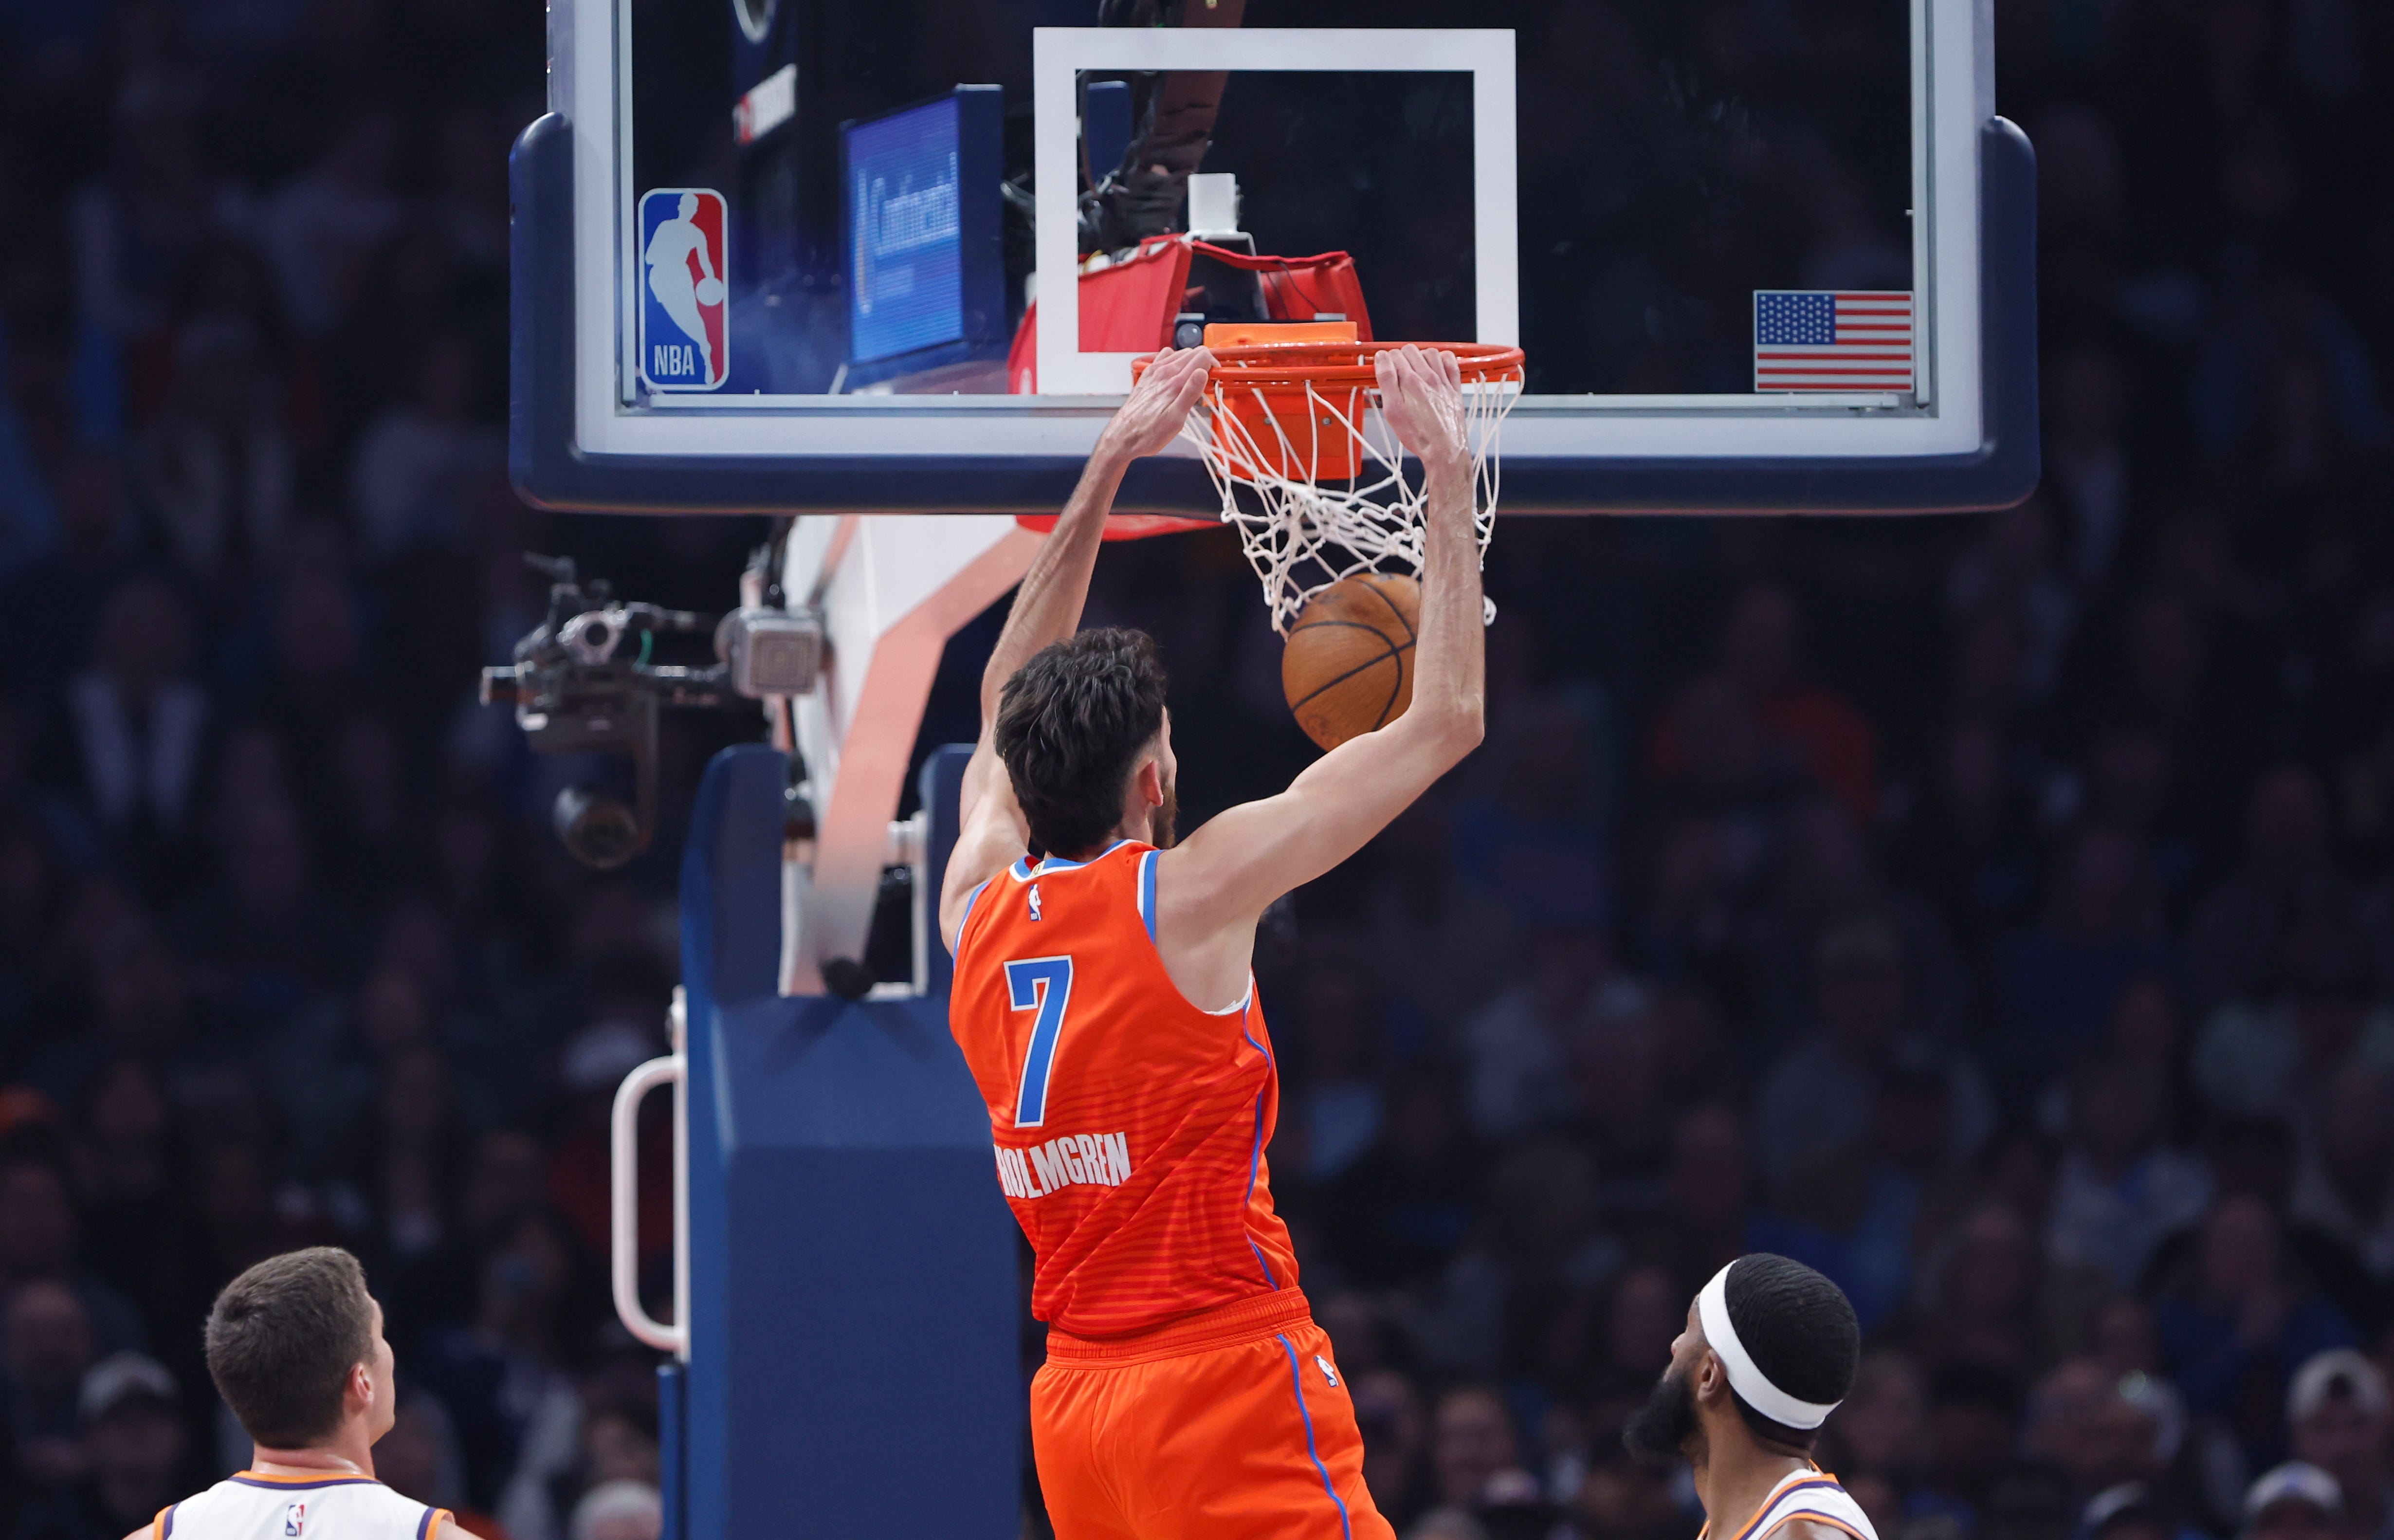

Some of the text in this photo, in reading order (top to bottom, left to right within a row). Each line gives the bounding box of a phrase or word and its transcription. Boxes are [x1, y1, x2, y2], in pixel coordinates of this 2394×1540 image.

[654, 345, 695, 376] NBA
[1004, 954, 1074, 1129] 7
[993, 1132, 1132, 1199] HOLMGREN
